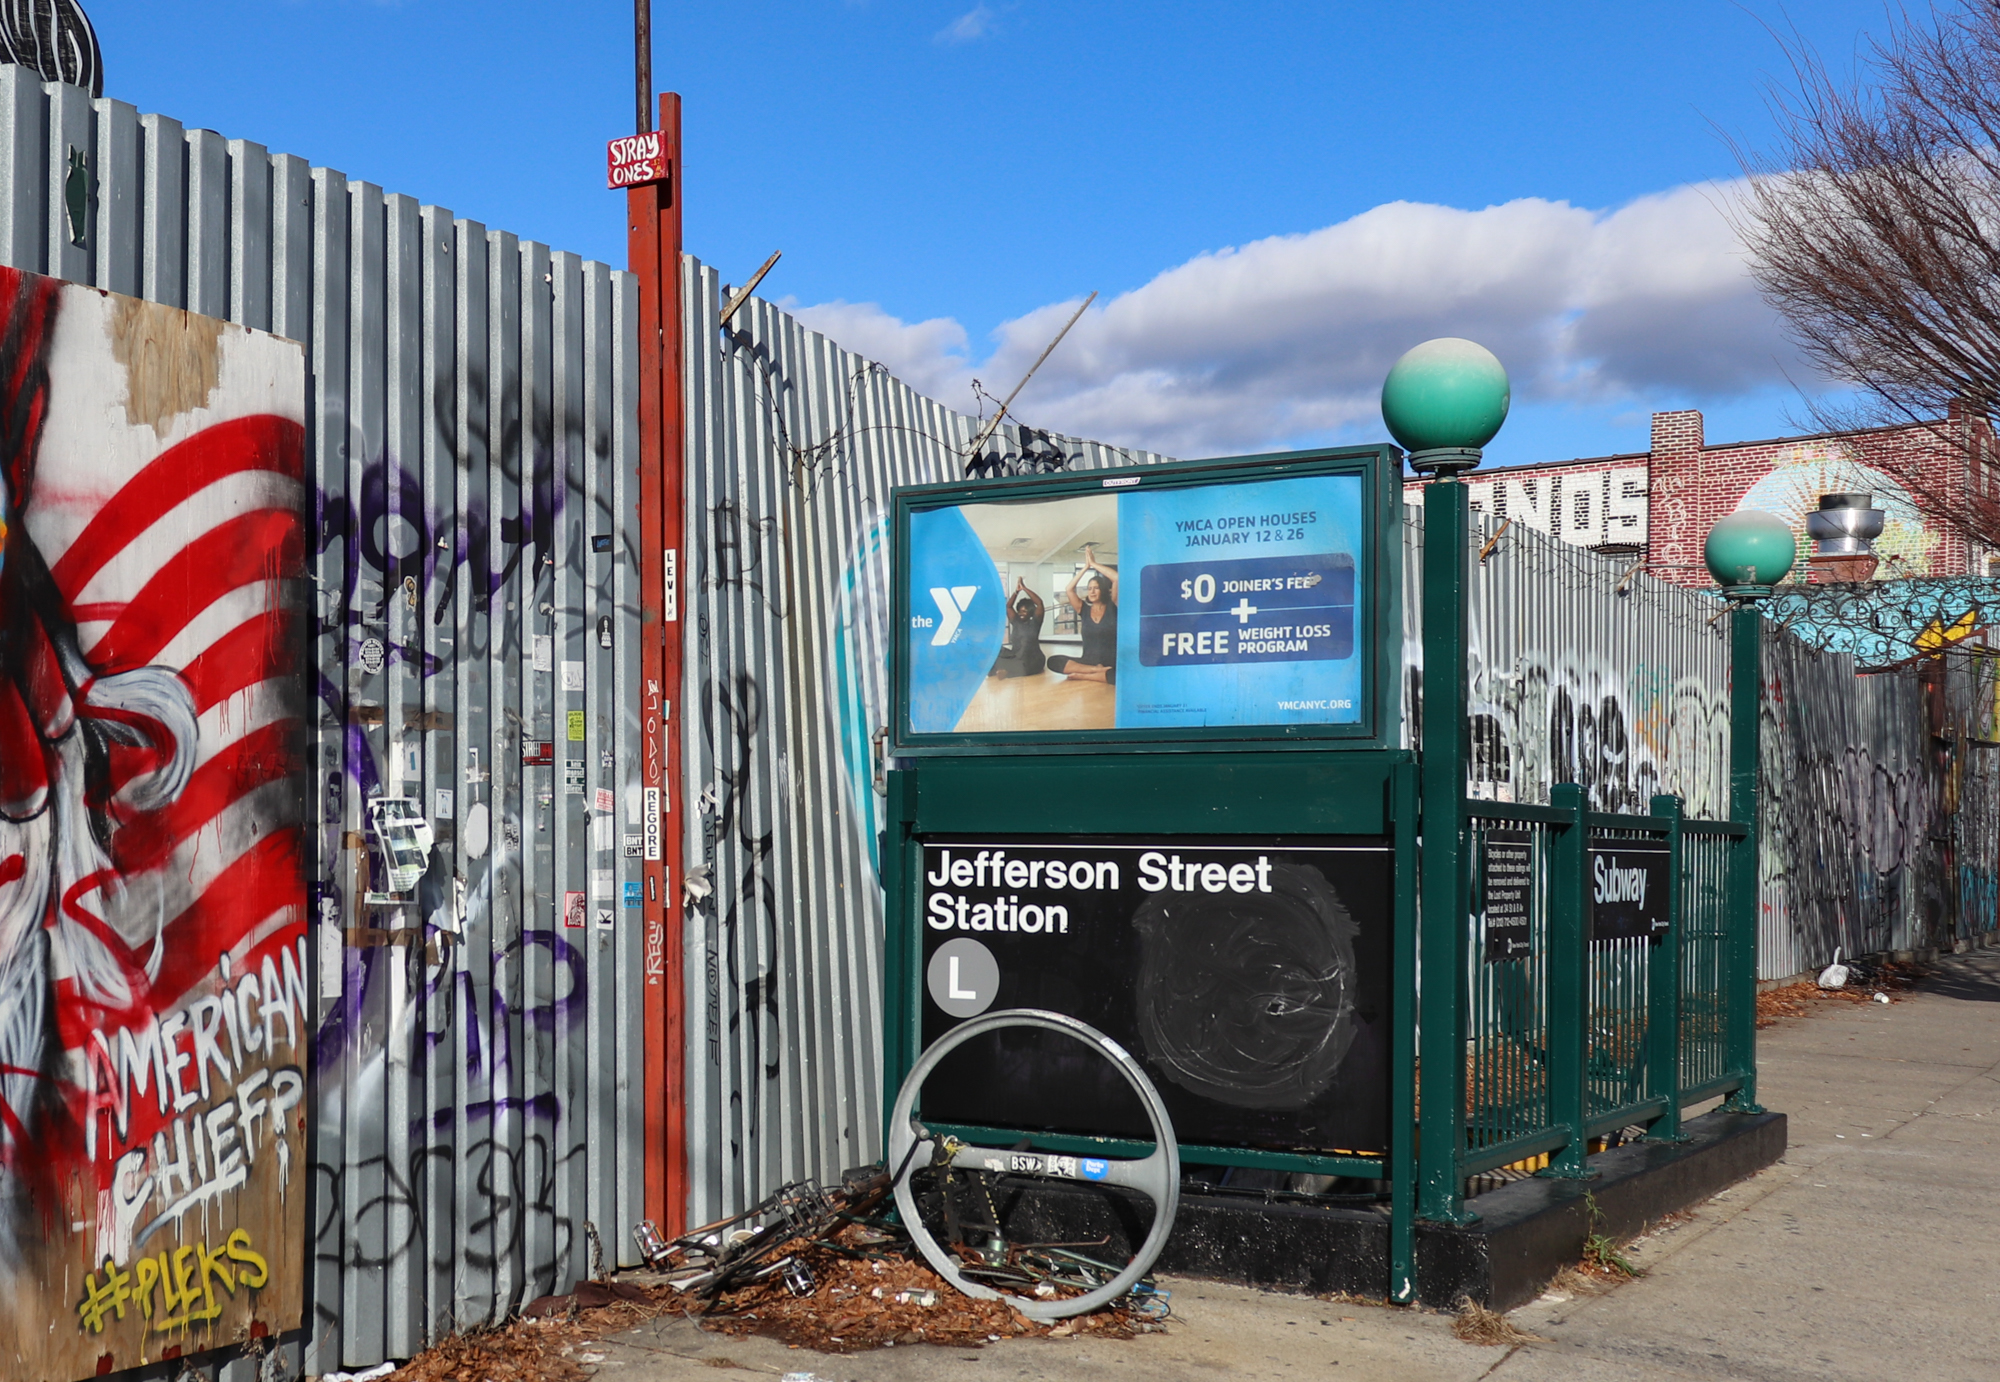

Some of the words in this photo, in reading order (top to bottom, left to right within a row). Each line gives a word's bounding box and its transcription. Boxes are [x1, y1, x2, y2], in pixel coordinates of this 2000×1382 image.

[610, 133, 660, 166] STRAY
[613, 160, 654, 185] ONES
[1175, 518, 1213, 533] YMCA
[1217, 515, 1257, 531] OPEN
[1260, 510, 1317, 528] HOUSES
[1185, 531, 1250, 547] JANUARY
[1255, 530, 1272, 544] 12
[1274, 528, 1286, 543] &
[1287, 527, 1305, 541] 26
[1181, 573, 1217, 604] $0
[1286, 575, 1311, 591] FEE
[911, 615, 933, 629] the
[1162, 631, 1230, 656] FREE
[1238, 626, 1294, 641] WEIGHT
[1297, 624, 1332, 639] LOSS
[1238, 638, 1309, 655] PROGRAM
[1277, 698, 1352, 712] YMCANYC.ORG
[647, 789, 657, 858] REGORE
[927, 850, 1120, 890] Jefferson
[1137, 851, 1273, 894] Street
[1594, 854, 1647, 911] Subway
[927, 893, 1069, 933] Station
[949, 956, 977, 999] L
[84, 934, 307, 1162] AMERICAN
